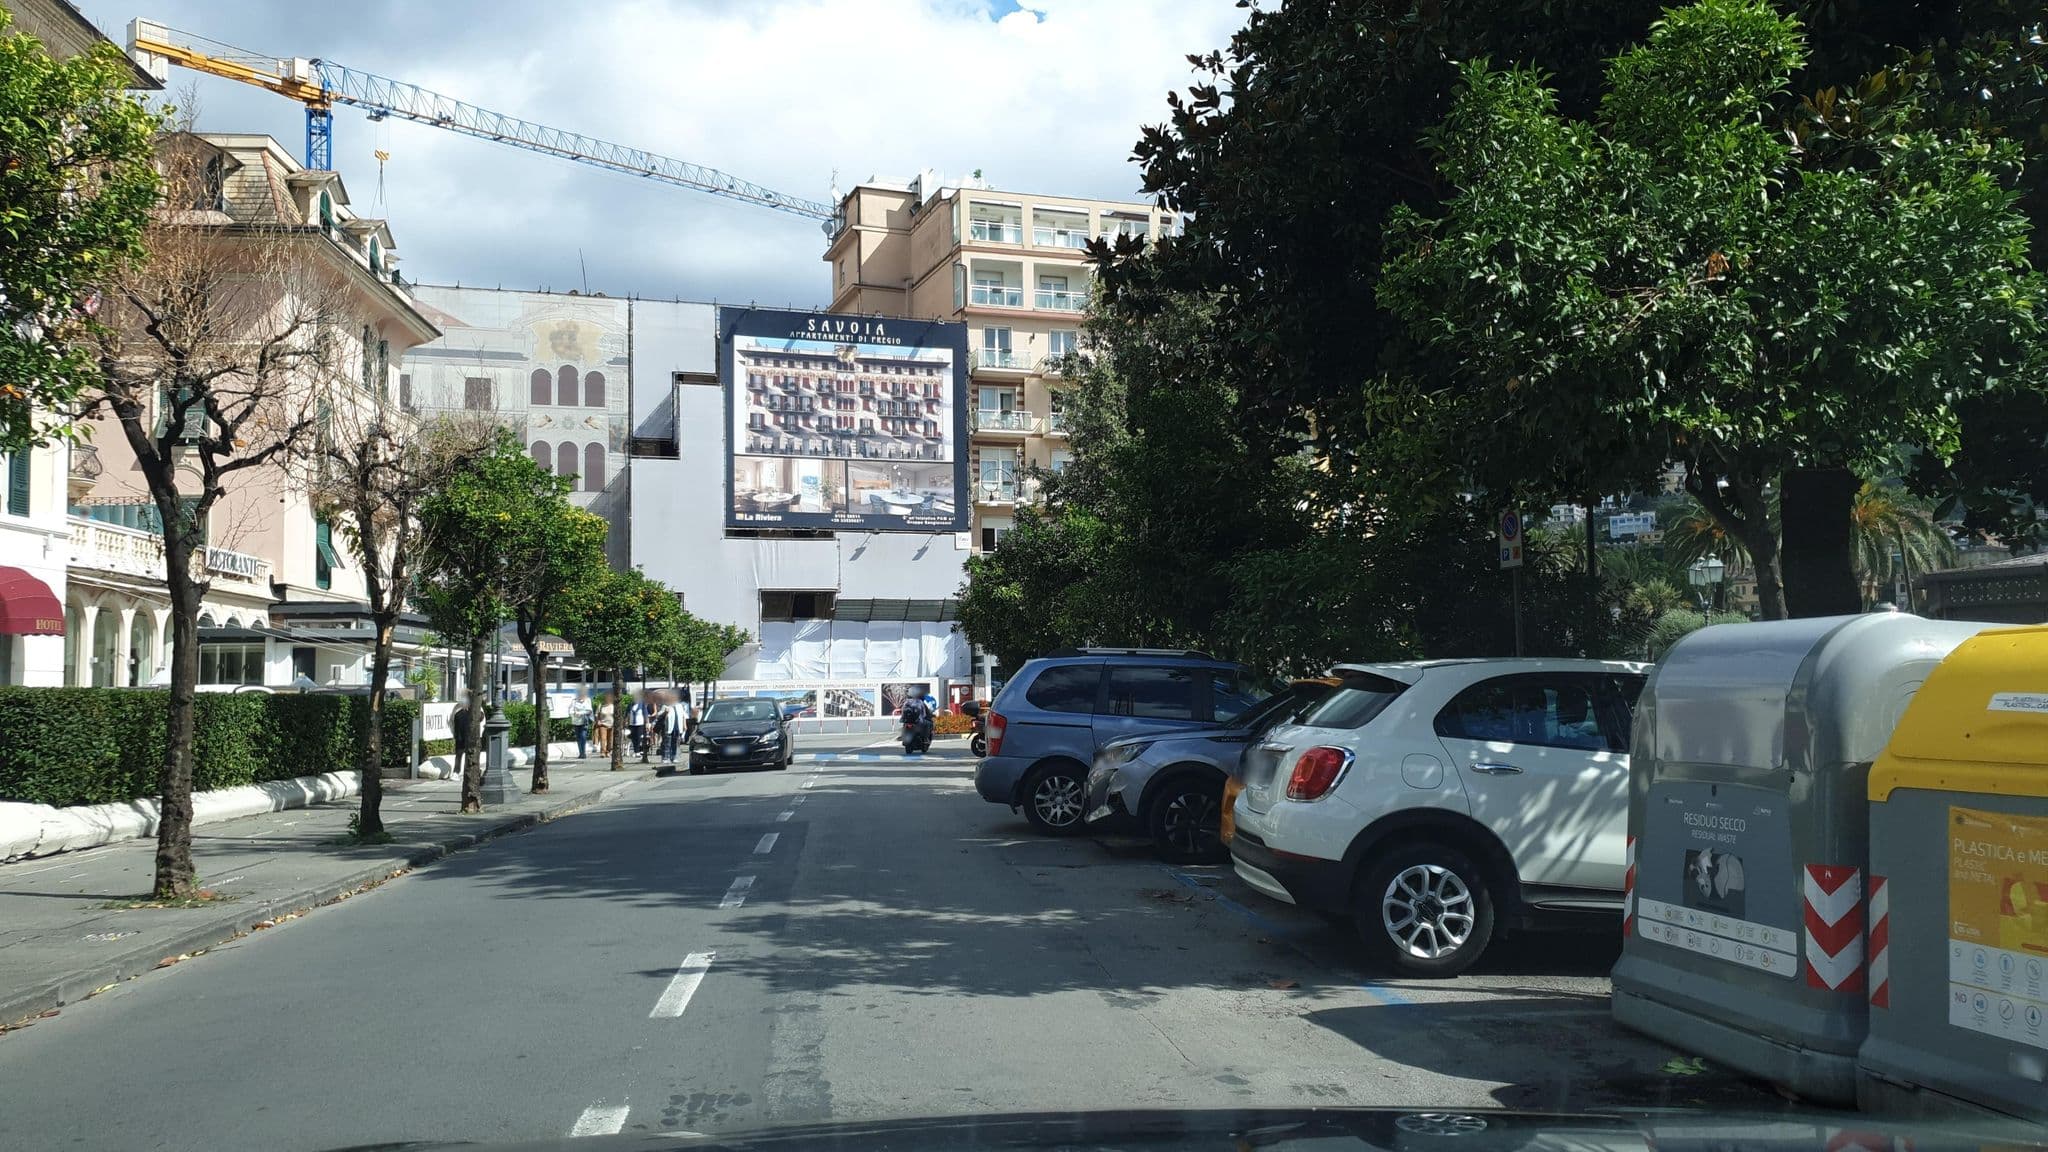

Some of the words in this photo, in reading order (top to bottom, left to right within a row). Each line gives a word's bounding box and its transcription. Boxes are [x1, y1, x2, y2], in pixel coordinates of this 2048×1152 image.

[808, 319, 885, 336] SAVOIA
[789, 331, 854, 343] APPARTAMENTI
[858, 335, 867, 343] DI
[871, 336, 901, 345] PREGIO
[208, 549, 257, 577] RISTORANTE
[36, 619, 62, 631] HOTEL
[539, 640, 574, 652] RIVIERA
[425, 714, 444, 731] HOTEL
[1683, 812, 1718, 829] RESIDUO
[1719, 816, 1746, 833] SECCO
[1717, 832, 1737, 845] WASTE
[1954, 837, 2014, 861] PLASTICA
[2018, 851, 2025, 863] e
[1954, 991, 1967, 1004] NO
